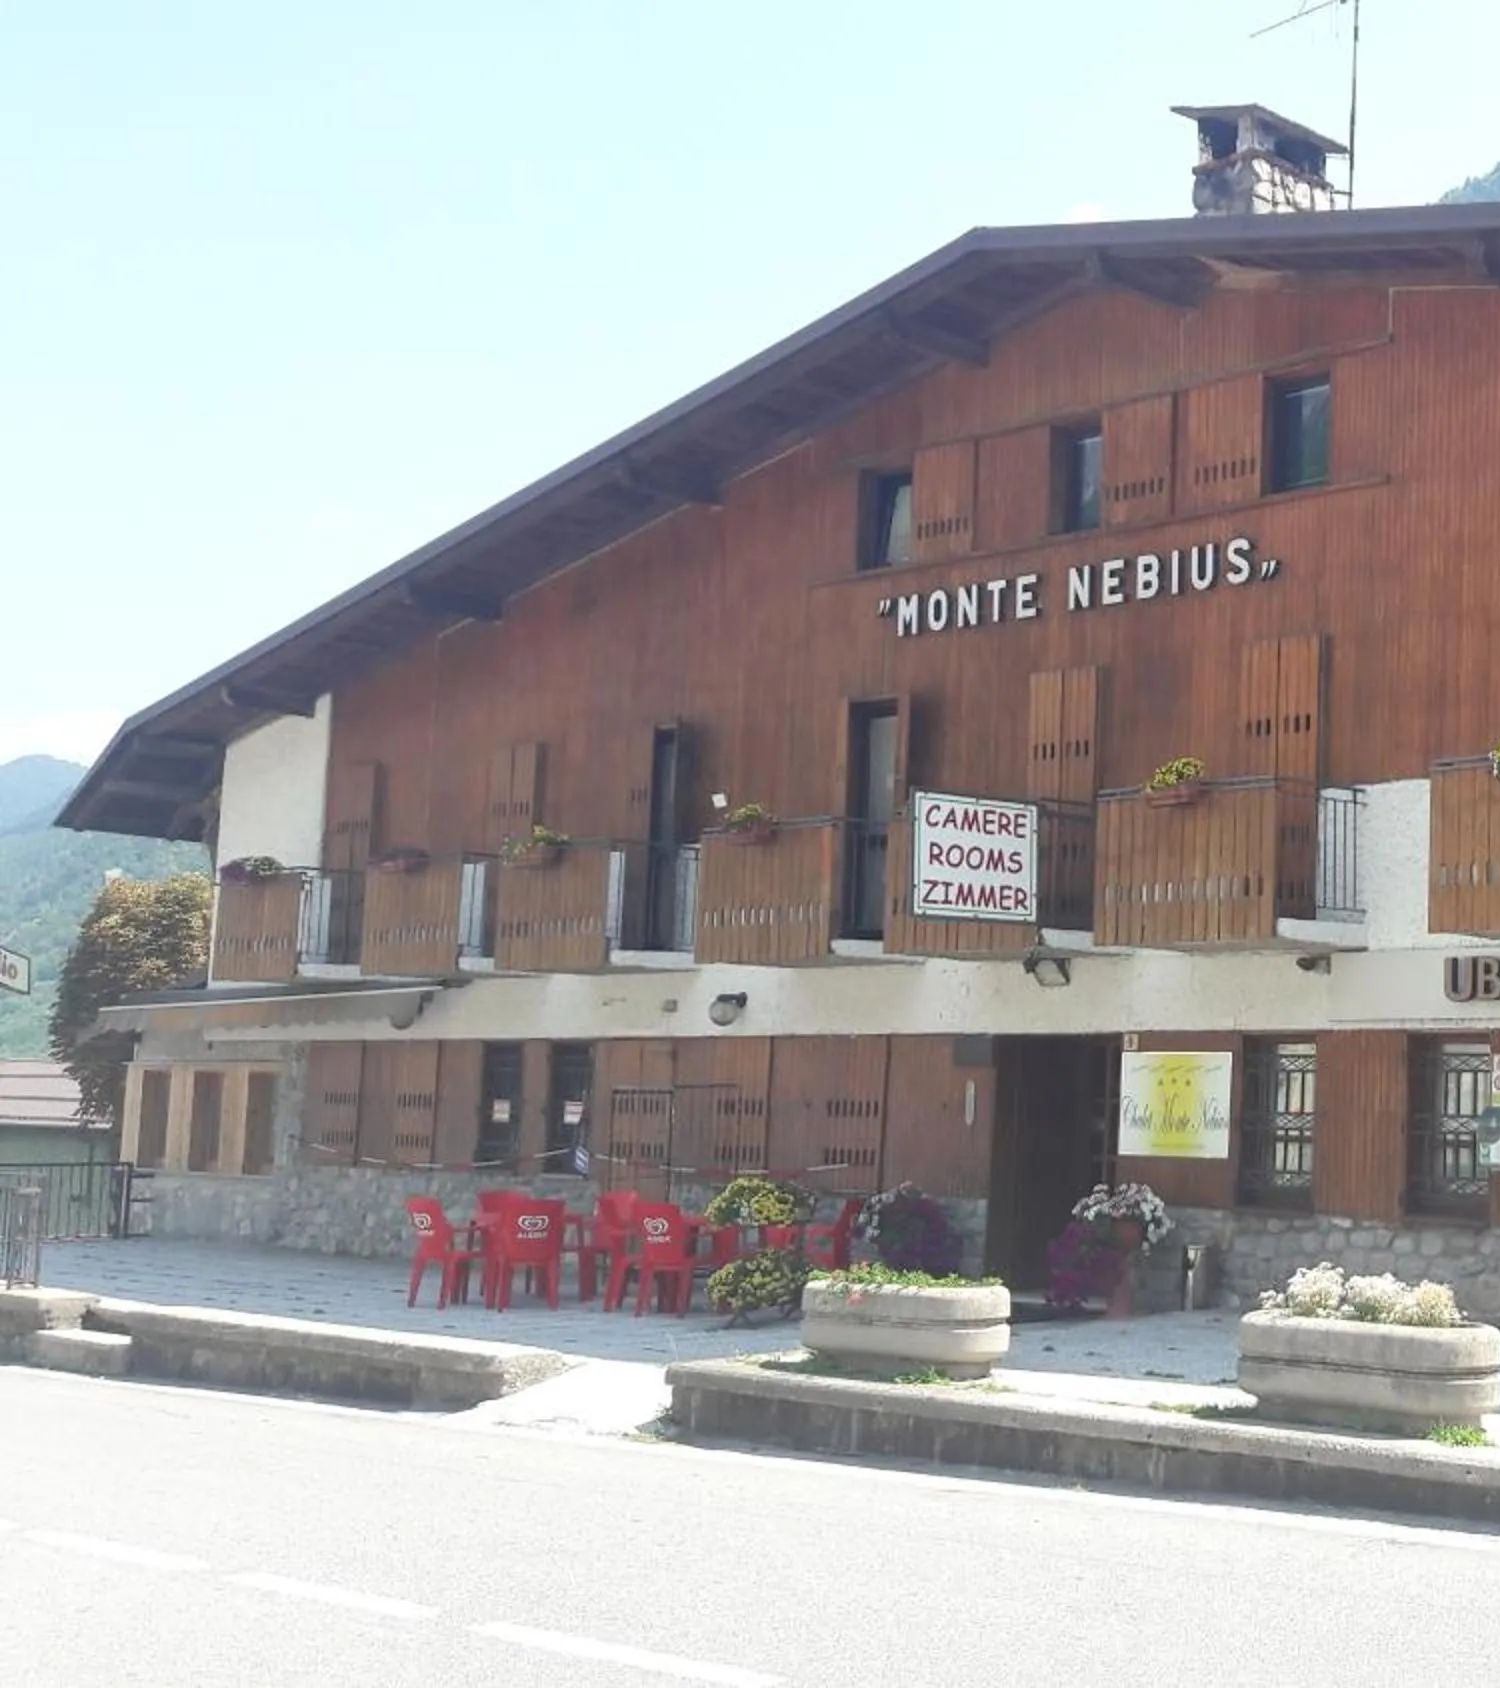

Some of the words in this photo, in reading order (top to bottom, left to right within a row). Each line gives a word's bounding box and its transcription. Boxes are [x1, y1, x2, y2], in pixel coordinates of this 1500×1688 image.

[925, 804, 1028, 839] CAMERE
[929, 841, 1023, 874] ROOMS
[922, 879, 1029, 911] ZIMMER
